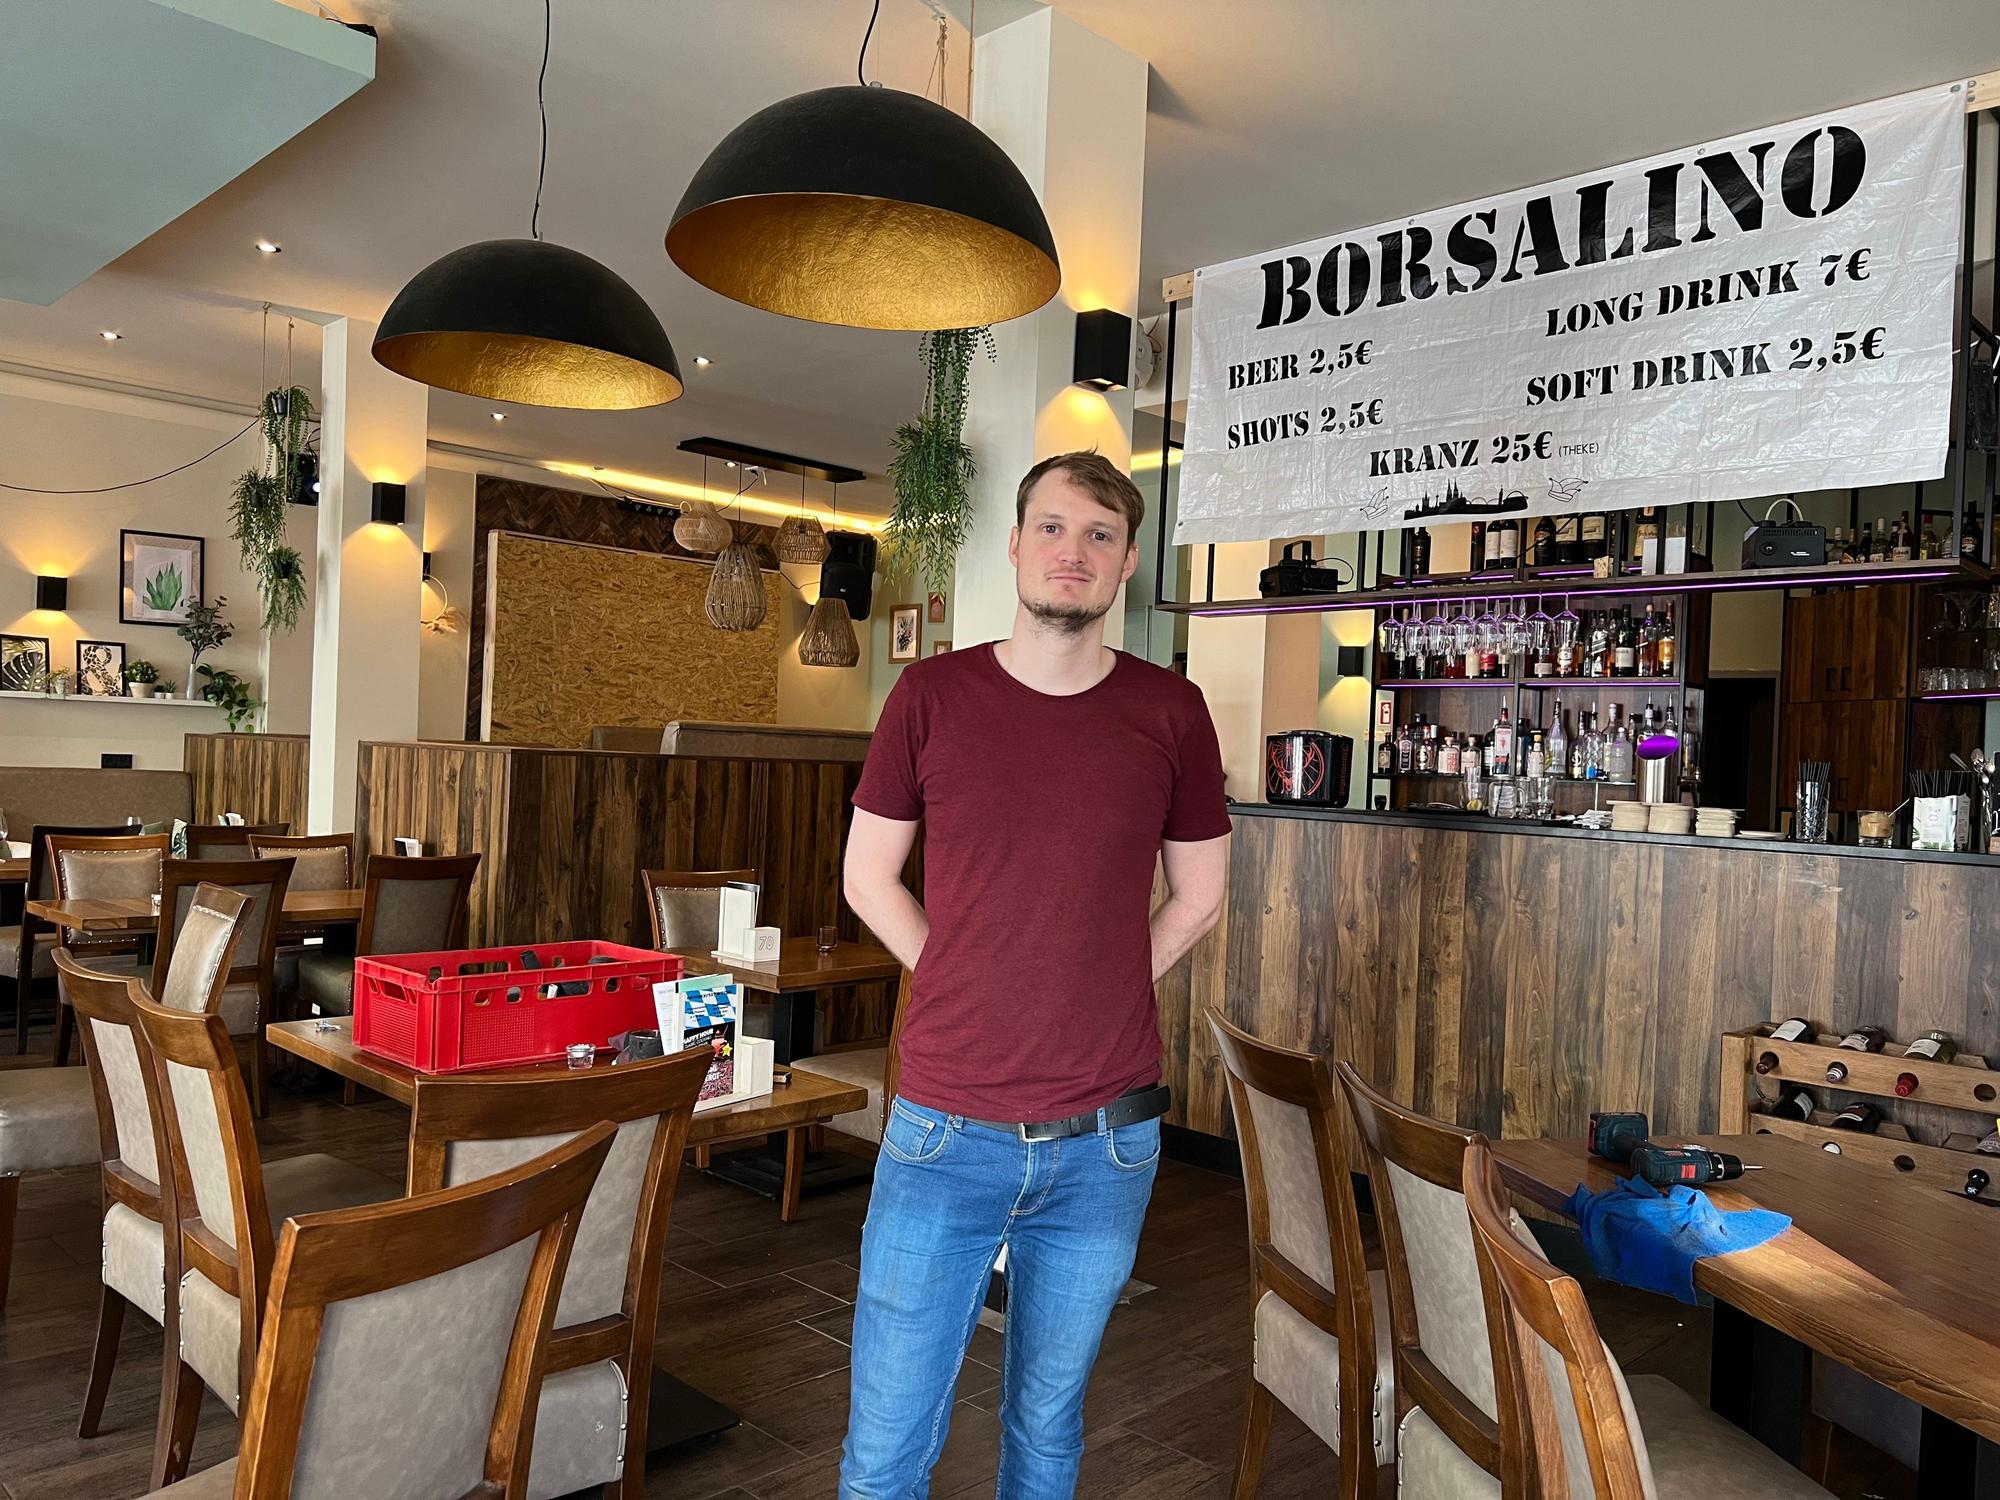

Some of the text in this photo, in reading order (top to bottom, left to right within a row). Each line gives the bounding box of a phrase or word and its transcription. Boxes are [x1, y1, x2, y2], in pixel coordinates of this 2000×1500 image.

[1256, 125, 1866, 330] BORSALINO
[1545, 248, 1872, 337] LONG DRINK 7€
[1228, 339, 1373, 391] BEER 2,5€
[1526, 326, 1886, 407] SOFT DRINK 2,5€
[1227, 398, 1384, 450] SHOTS 2,5€
[1368, 430, 1600, 478] KRANZ 25€ (THEKE)
[759, 935, 775, 951] 70
